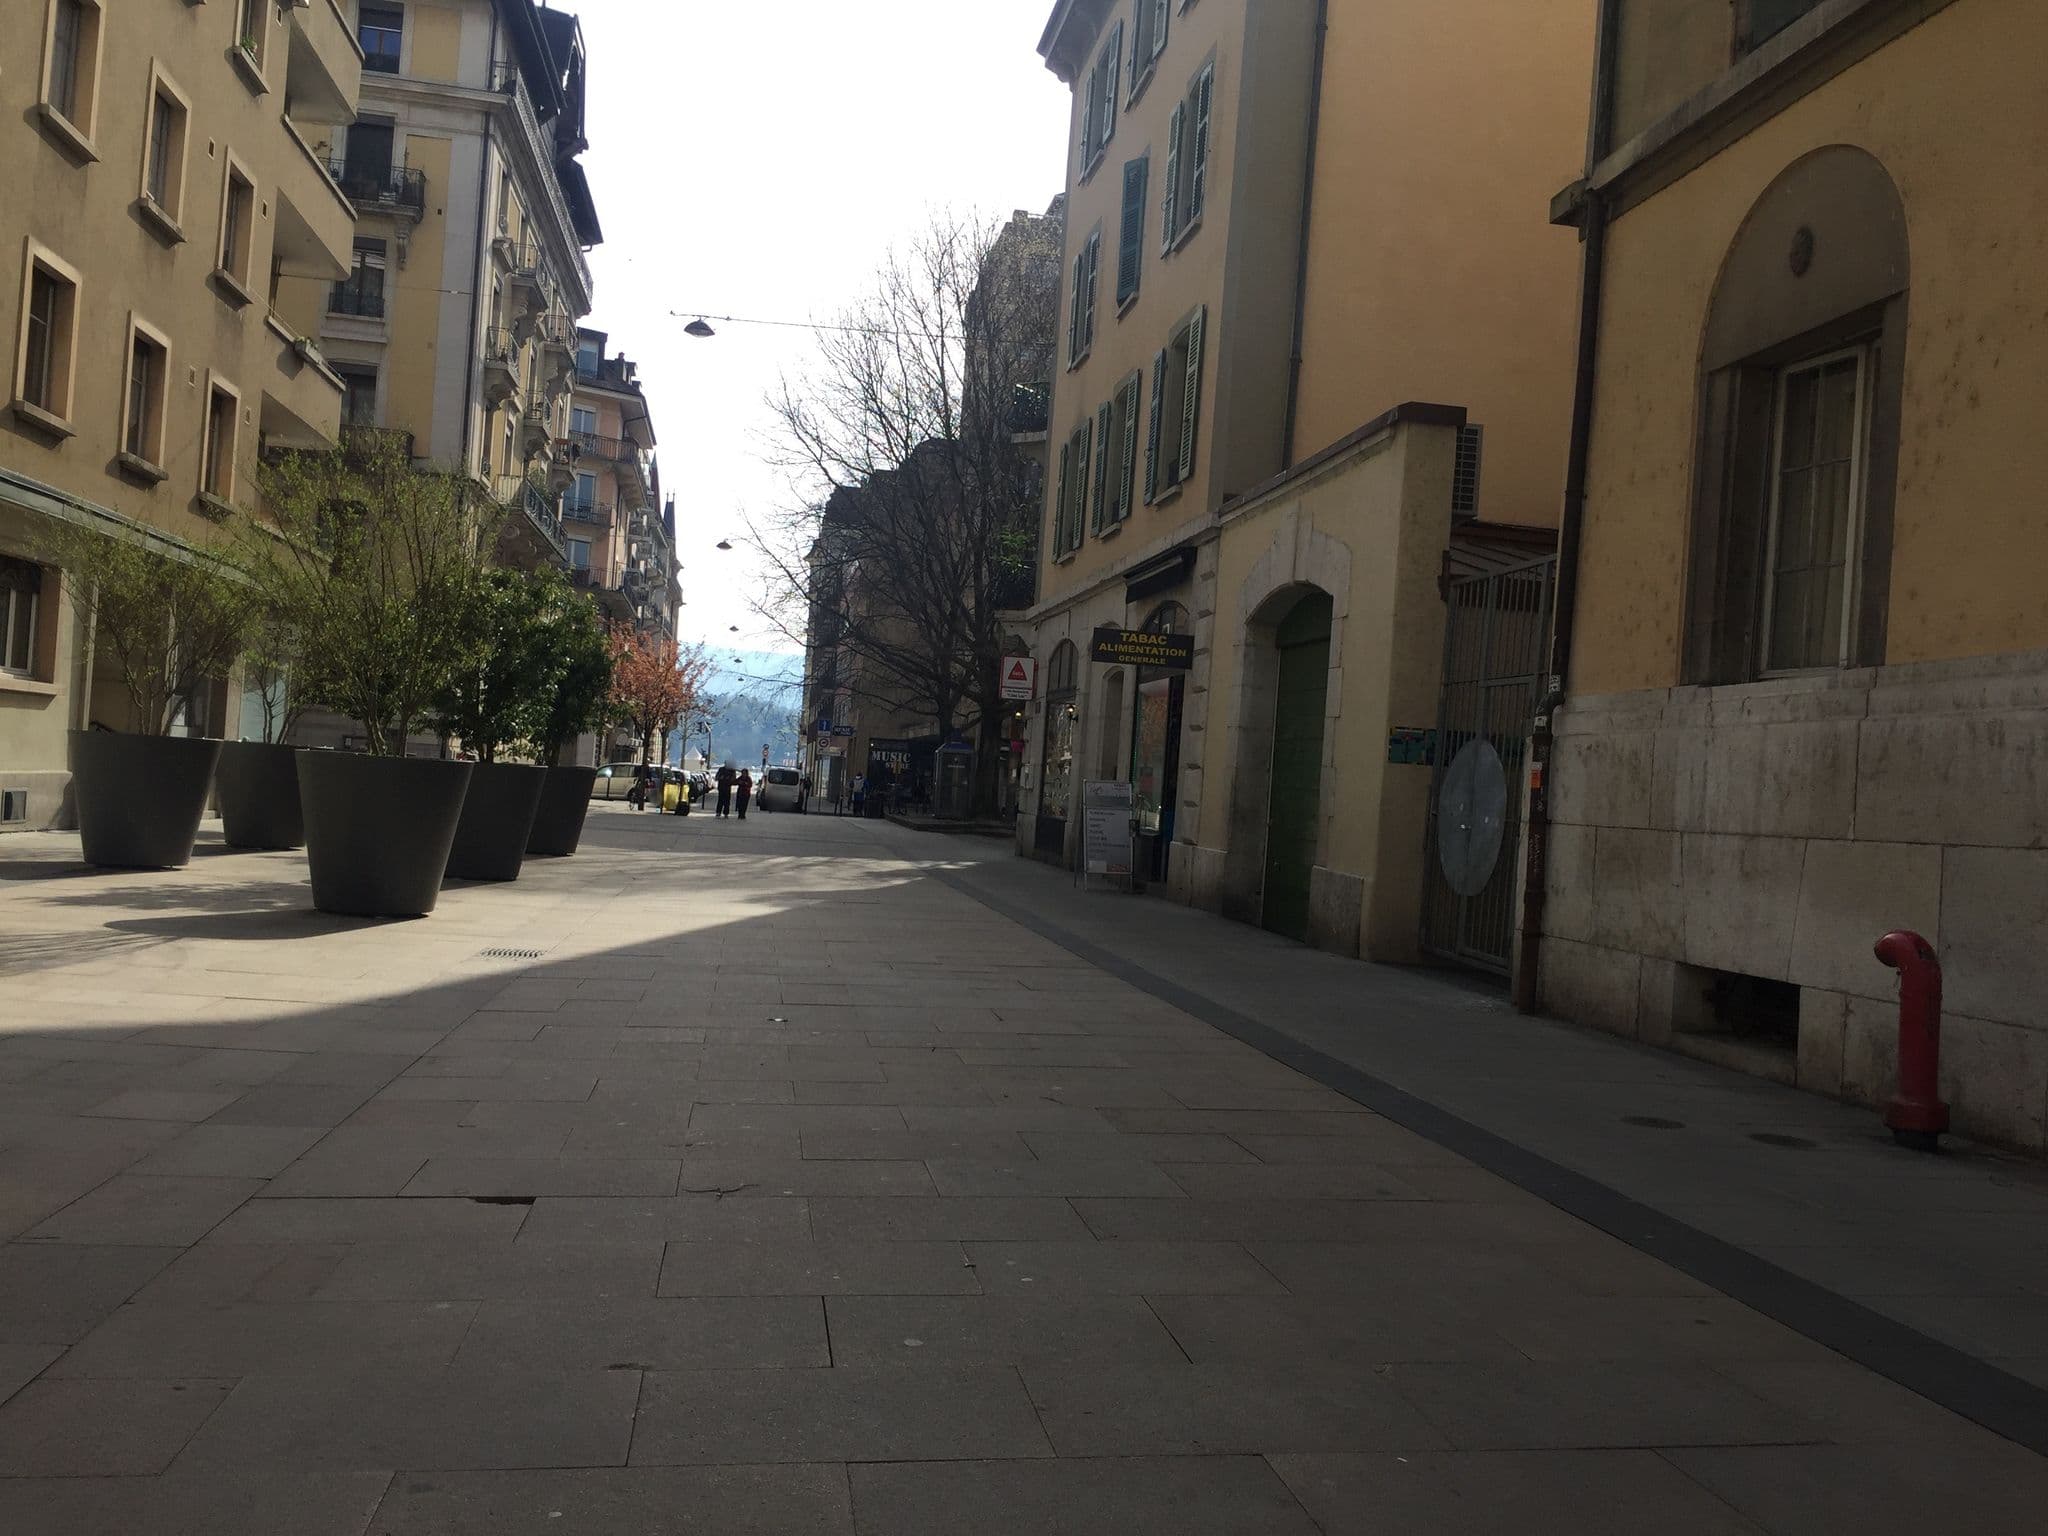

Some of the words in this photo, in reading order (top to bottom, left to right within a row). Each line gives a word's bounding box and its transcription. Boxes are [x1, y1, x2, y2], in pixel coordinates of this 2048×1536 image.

[1120, 632, 1168, 645] TABAC
[1099, 642, 1186, 657] ALIMENTATION
[871, 750, 912, 763] MUSIC
